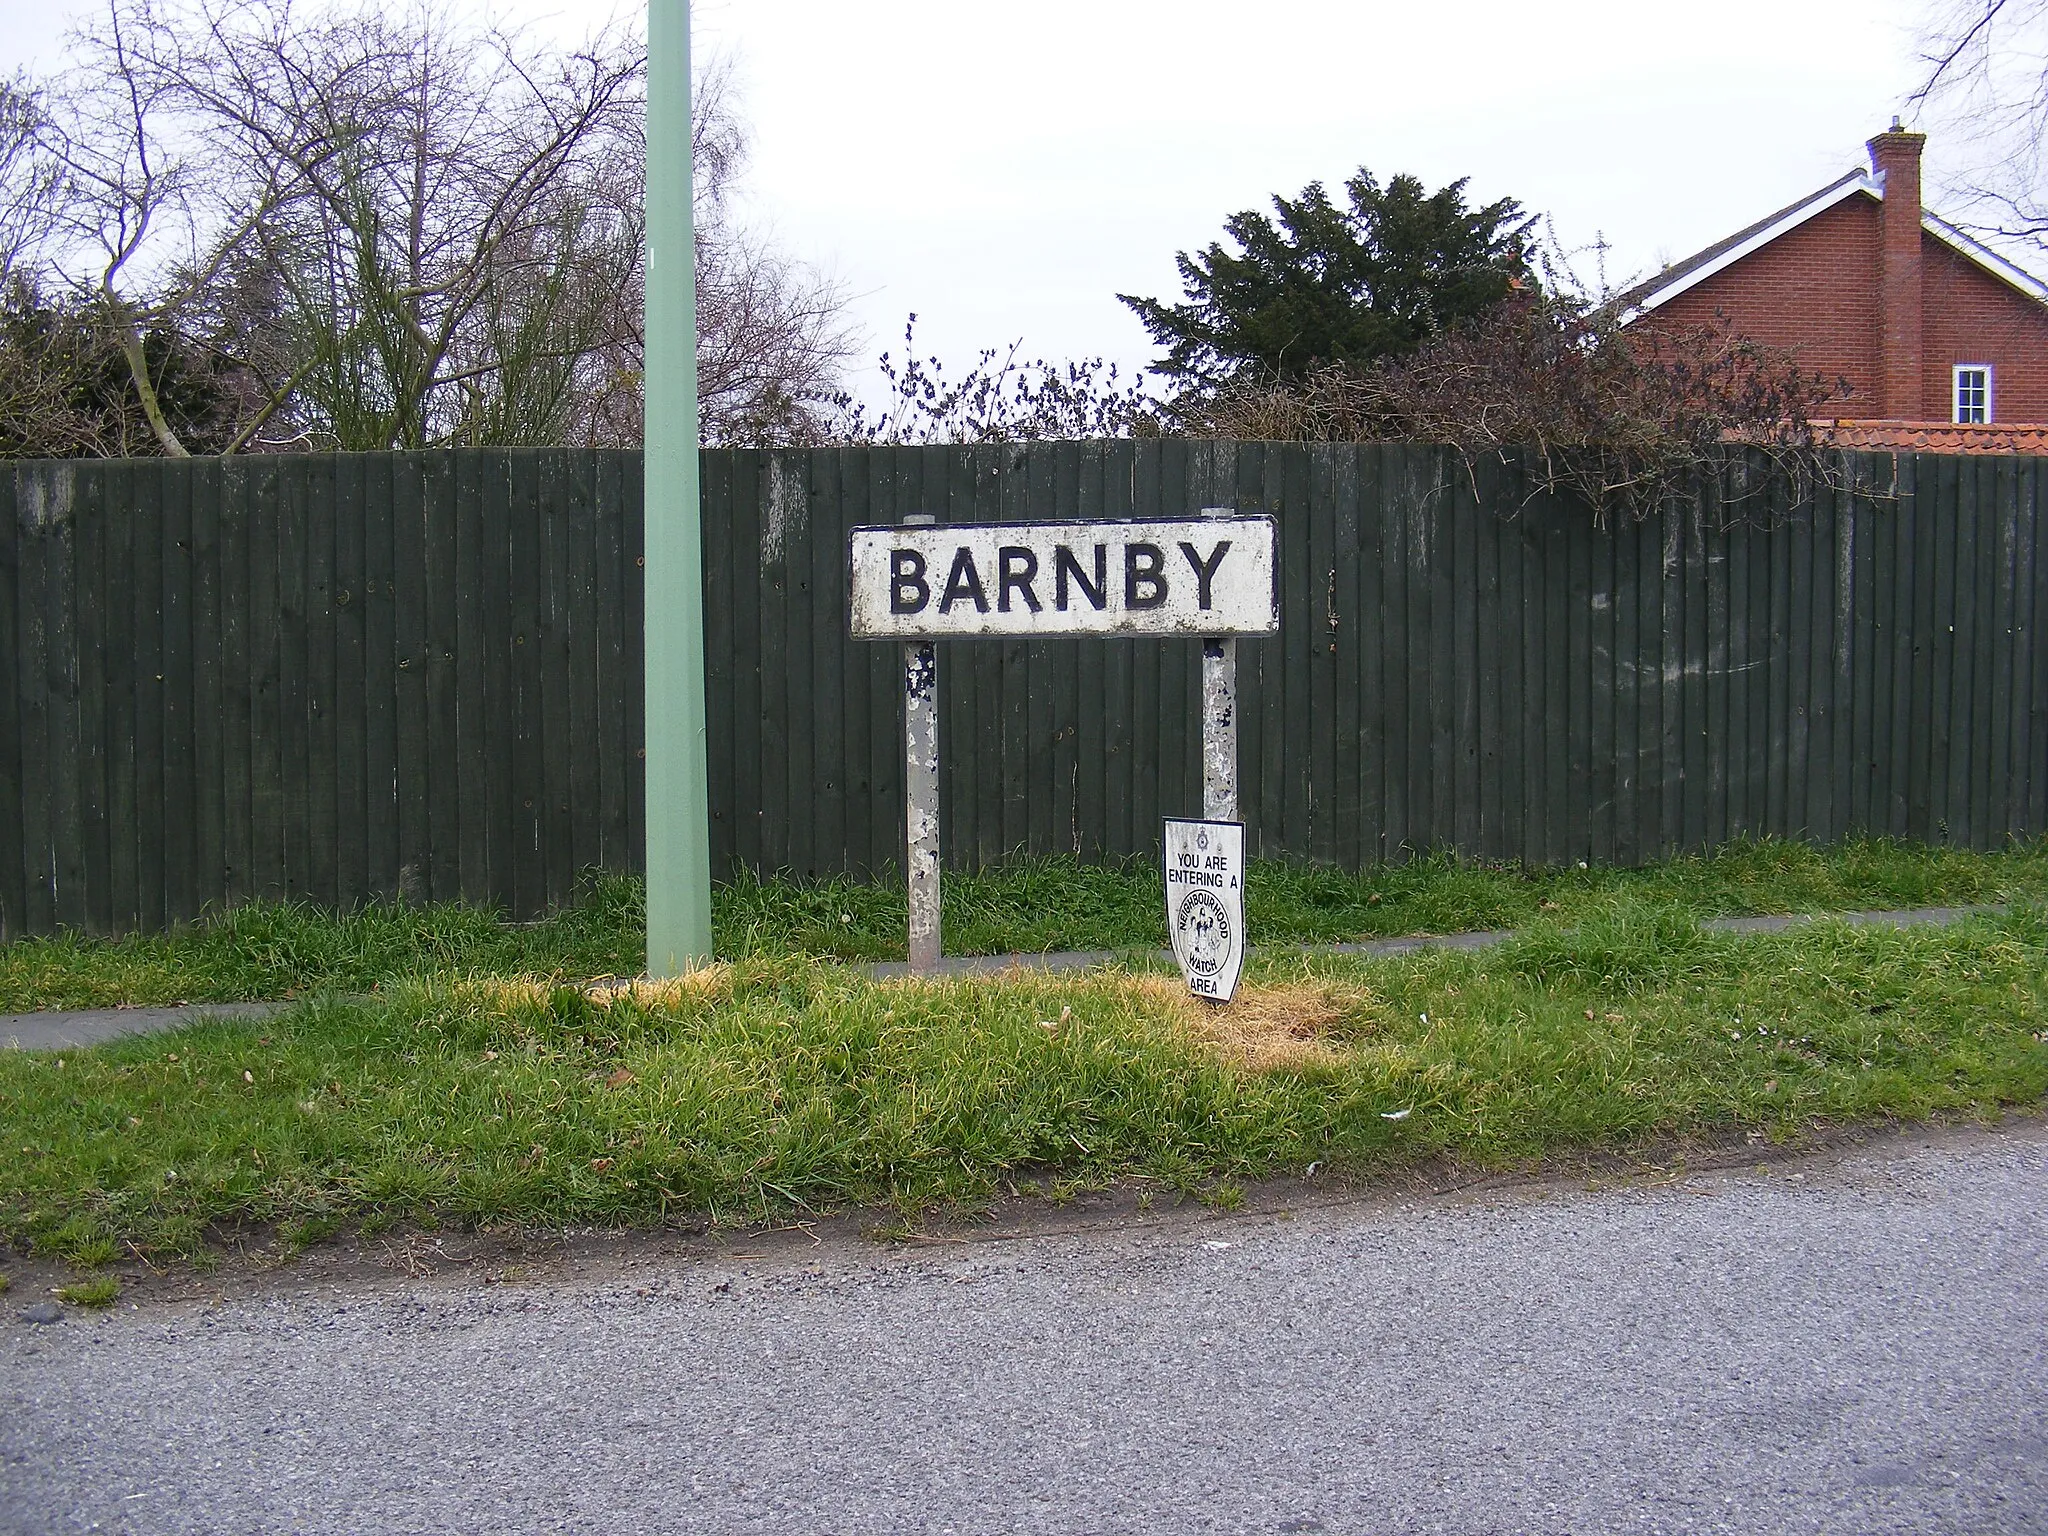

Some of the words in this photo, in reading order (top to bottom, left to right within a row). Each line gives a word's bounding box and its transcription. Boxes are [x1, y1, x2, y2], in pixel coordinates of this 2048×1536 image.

[890, 540, 1233, 615] BARNBY
[1177, 853, 1199, 868] YOU
[1204, 856, 1228, 871] ARE
[1168, 869, 1223, 888] ENTERING
[1230, 875, 1238, 889] A
[1179, 892, 1228, 939] NEIGHBOURHOOD
[1189, 952, 1218, 973] WATCH
[1190, 977, 1218, 995] AREA
